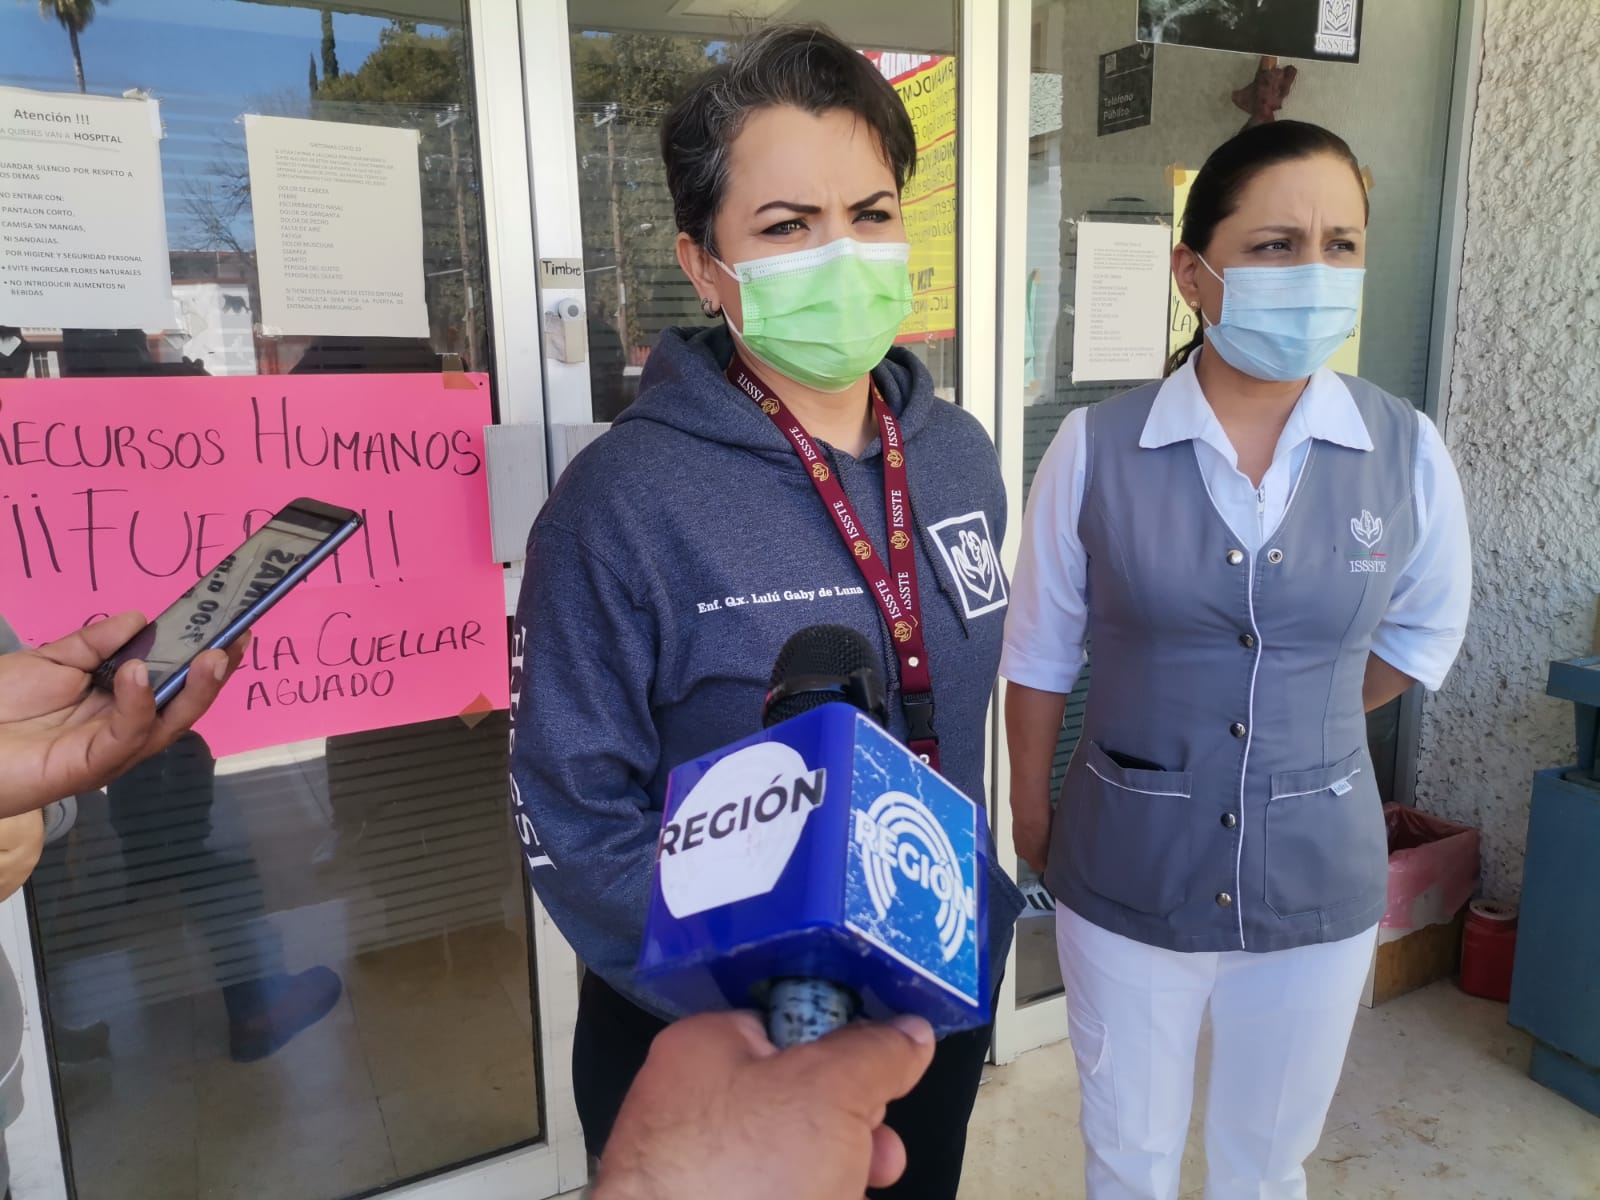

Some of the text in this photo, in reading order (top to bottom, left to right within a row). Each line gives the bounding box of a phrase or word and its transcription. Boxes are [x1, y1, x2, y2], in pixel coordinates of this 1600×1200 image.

[14, 109, 90, 125] Atención !!!
[8, 128, 43, 137] QUIENES
[45, 131, 63, 139] VAN
[74, 132, 123, 144] HOSPITAL
[0, 162, 33, 171] UARDAR
[36, 164, 70, 173] SILENCIO
[93, 168, 125, 177] RESPETO
[12, 172, 40, 181] DEMAS
[12, 192, 43, 201] ENTRAR
[1, 206, 45, 215] PANTALON
[1, 221, 33, 229] CAMISA
[34, 222, 47, 230] SIN
[24, 250, 54, 259] HIGIENE
[63, 252, 106, 261] SEGURIDAD
[108, 254, 143, 263] PERSONAL
[31, 265, 69, 274] INGRESAR
[71, 267, 98, 275] FLORES
[99, 268, 142, 277] NATURALES
[542, 261, 581, 276] Timbre
[11, 289, 44, 297] BEBIDAS
[24, 280, 71, 289] INTRODUCIR
[73, 282, 116, 291] ALIMENTOS
[737, 372, 764, 403] ISSSTE
[251, 396, 482, 477] HUMANOS
[883, 414, 899, 447] ISSSTE
[789, 426, 817, 461] ISSSTE
[891, 490, 904, 528] ISSSTE
[833, 500, 860, 539] ISSSTE
[1349, 560, 1387, 573] ISSSTE
[696, 599, 722, 614] Enf.
[751, 591, 781, 604] Lulú
[784, 590, 815, 602] Gaby
[818, 588, 833, 598] de
[834, 586, 864, 596] Luna
[875, 579, 902, 620] ISSSTE
[316, 612, 486, 667] CUELLAR
[246, 669, 395, 711] AGUADO
[658, 768, 826, 857] REGIÓN
[853, 809, 976, 920] REGIÓN
